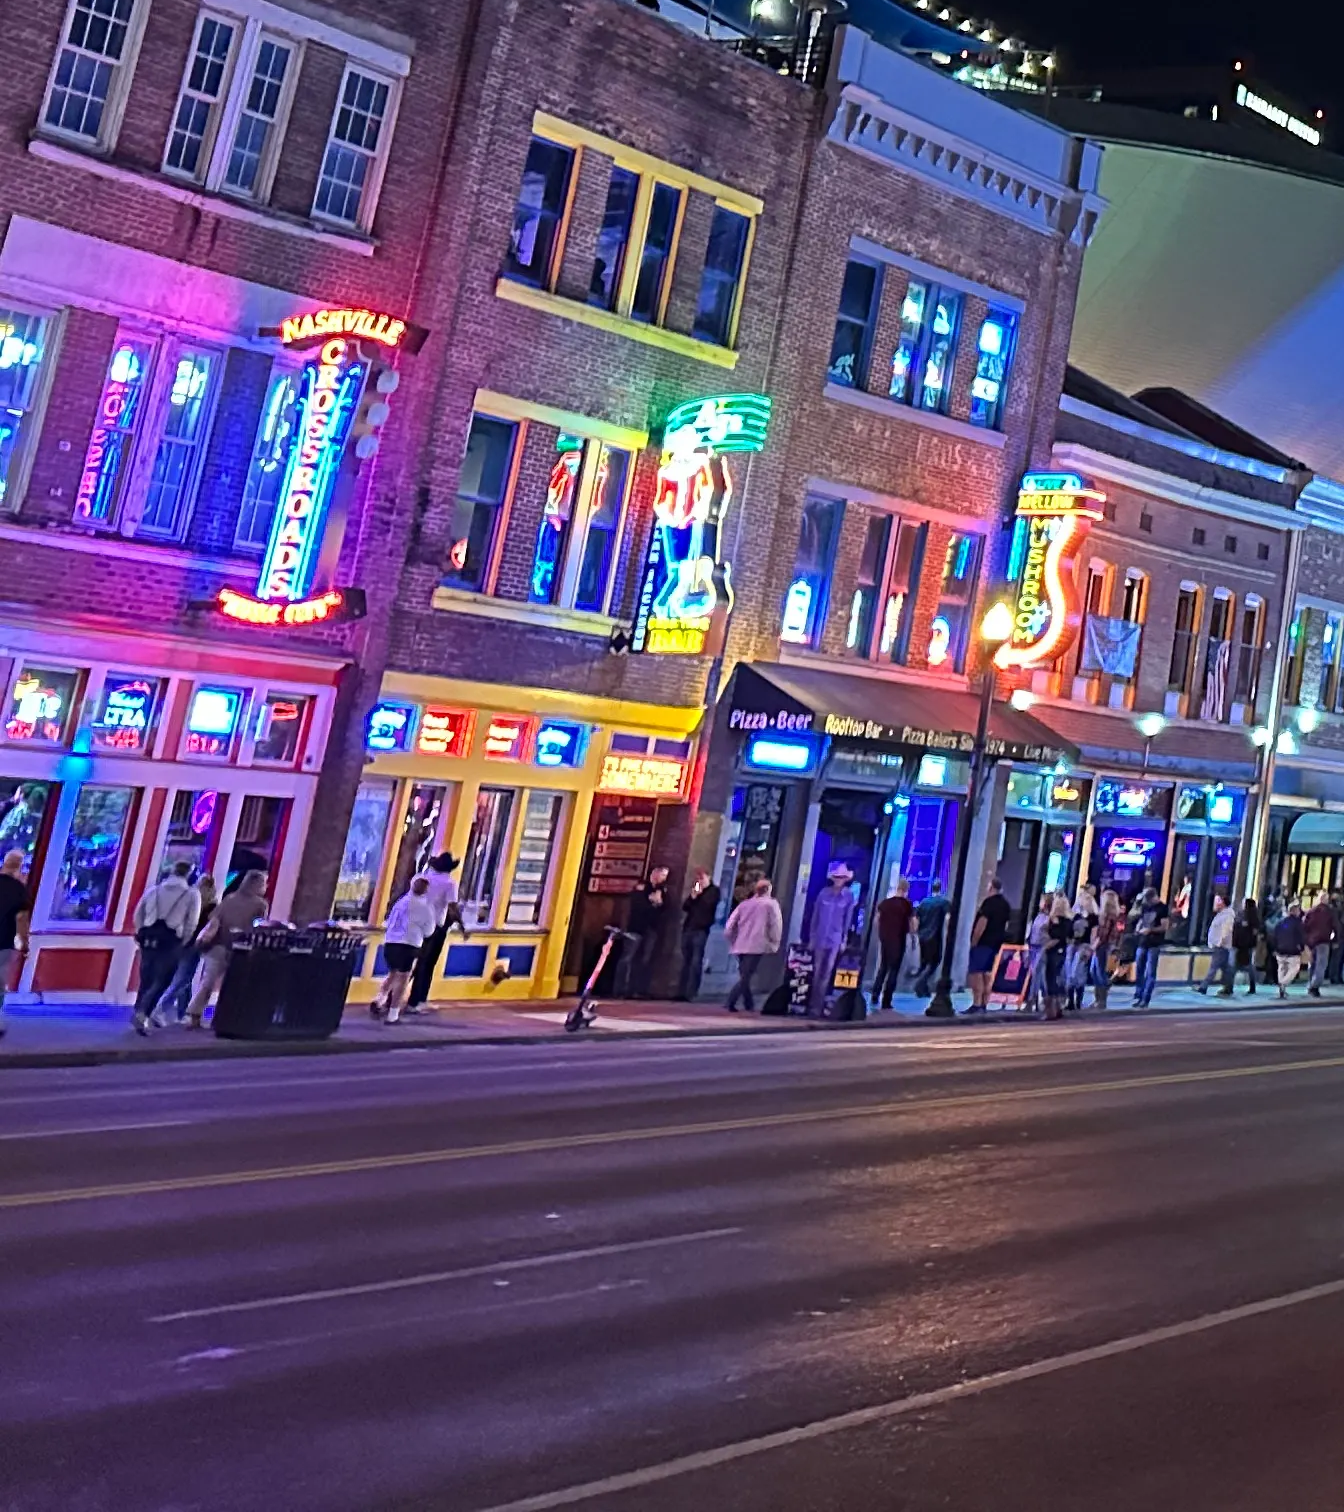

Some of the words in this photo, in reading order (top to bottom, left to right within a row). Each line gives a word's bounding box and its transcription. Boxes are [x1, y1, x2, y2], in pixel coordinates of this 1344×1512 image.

[281, 309, 406, 346] NASHVILLE
[268, 337, 347, 598] CROSSROADS
[1018, 494, 1076, 510] MELLOW
[1013, 515, 1050, 644] MUSHROOM
[729, 708, 767, 730] Pizza
[776, 710, 812, 731] Beer
[825, 713, 865, 738] Rooftop
[865, 720, 883, 739] Bar
[901, 727, 925, 746] Pizza
